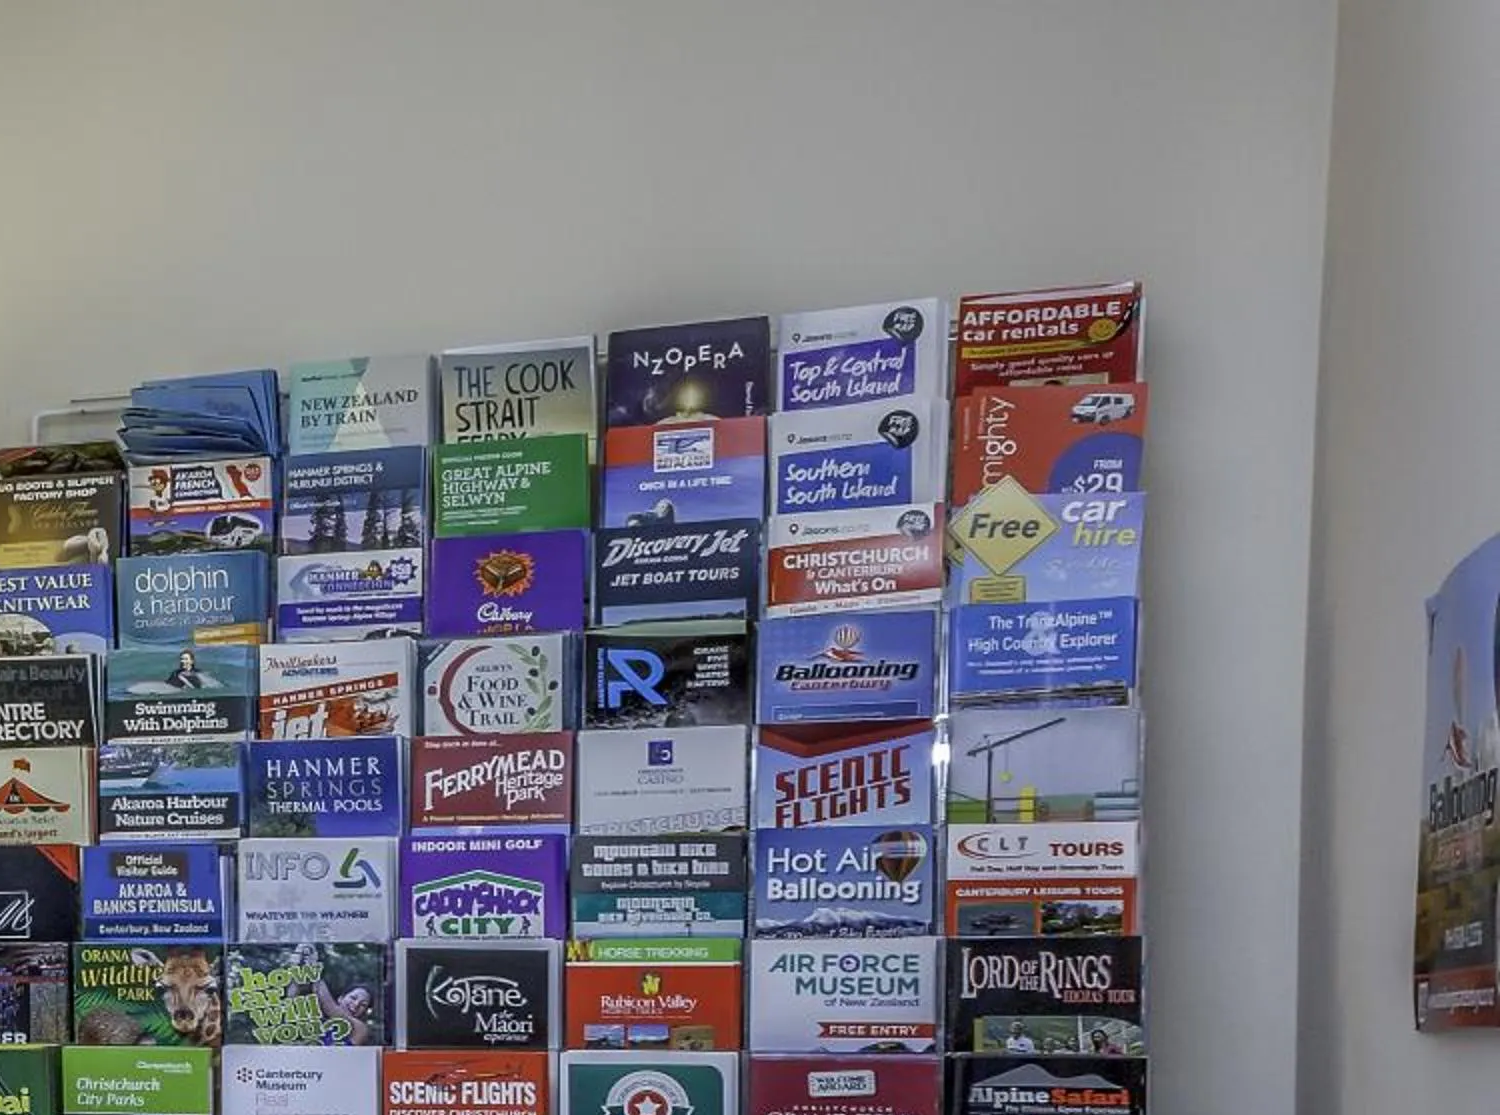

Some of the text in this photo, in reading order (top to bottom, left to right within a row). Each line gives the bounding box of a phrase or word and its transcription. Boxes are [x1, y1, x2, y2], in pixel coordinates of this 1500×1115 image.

[963, 301, 1120, 326] AFFORDABLE
[963, 322, 1079, 342] car rentals
[454, 359, 575, 398] THE COOK
[301, 390, 418, 412] NEW ZEALAND
[301, 408, 378, 428] BY TRAIN
[456, 397, 541, 432] STRAIT
[442, 462, 551, 483] GREAT ALPINE
[1094, 459, 1123, 471] FROM
[442, 492, 505, 508] SELWYN
[1062, 500, 1127, 523] car
[969, 513, 1041, 539] Free
[1074, 524, 1137, 546] hire
[783, 547, 929, 570] CHRISTCHURCH
[36, 573, 92, 589] VALUE
[136, 565, 228, 597] dolphin
[610, 567, 739, 587] JET BOAT TOURS
[815, 577, 897, 596] What's On
[133, 594, 235, 615] & harbour
[776, 662, 918, 682] Ballooning
[467, 676, 519, 692] FOOD
[135, 701, 216, 717] Swimming
[458, 693, 527, 710] & WINE
[123, 716, 229, 732] With Dolphins
[467, 710, 519, 726] TRAIL
[267, 757, 381, 778] HANMER
[267, 779, 383, 800] SPRINGS
[424, 750, 565, 811] FERRYMEAD
[111, 795, 228, 812] Akaroa Harbour
[269, 799, 383, 814] THERMAL POOLS
[115, 812, 224, 827] Nature Cruises
[412, 839, 543, 852] INDOOR MINI GOLF
[767, 847, 880, 873] Hot Air
[119, 882, 187, 898] AKAROA &
[767, 879, 920, 903] Ballooning
[93, 899, 215, 914] BANKS PENINSULA
[440, 918, 515, 935] CITY
[81, 950, 131, 964] ORANA
[769, 953, 920, 974] AIR FORCE
[960, 948, 1020, 999] LORD
[1021, 960, 1037, 974] OF
[1040, 951, 1112, 999] RINGS
[117, 987, 155, 1001] PARK
[794, 976, 920, 996] MUSEUM
[601, 995, 697, 1013] Rubicon Valley
[829, 1024, 919, 1036] FREE ENTRY
[256, 1068, 323, 1081] Canterbury
[76, 1078, 161, 1092] Christchurch
[256, 1080, 308, 1091] Museum
[77, 1092, 146, 1107] City Parks
